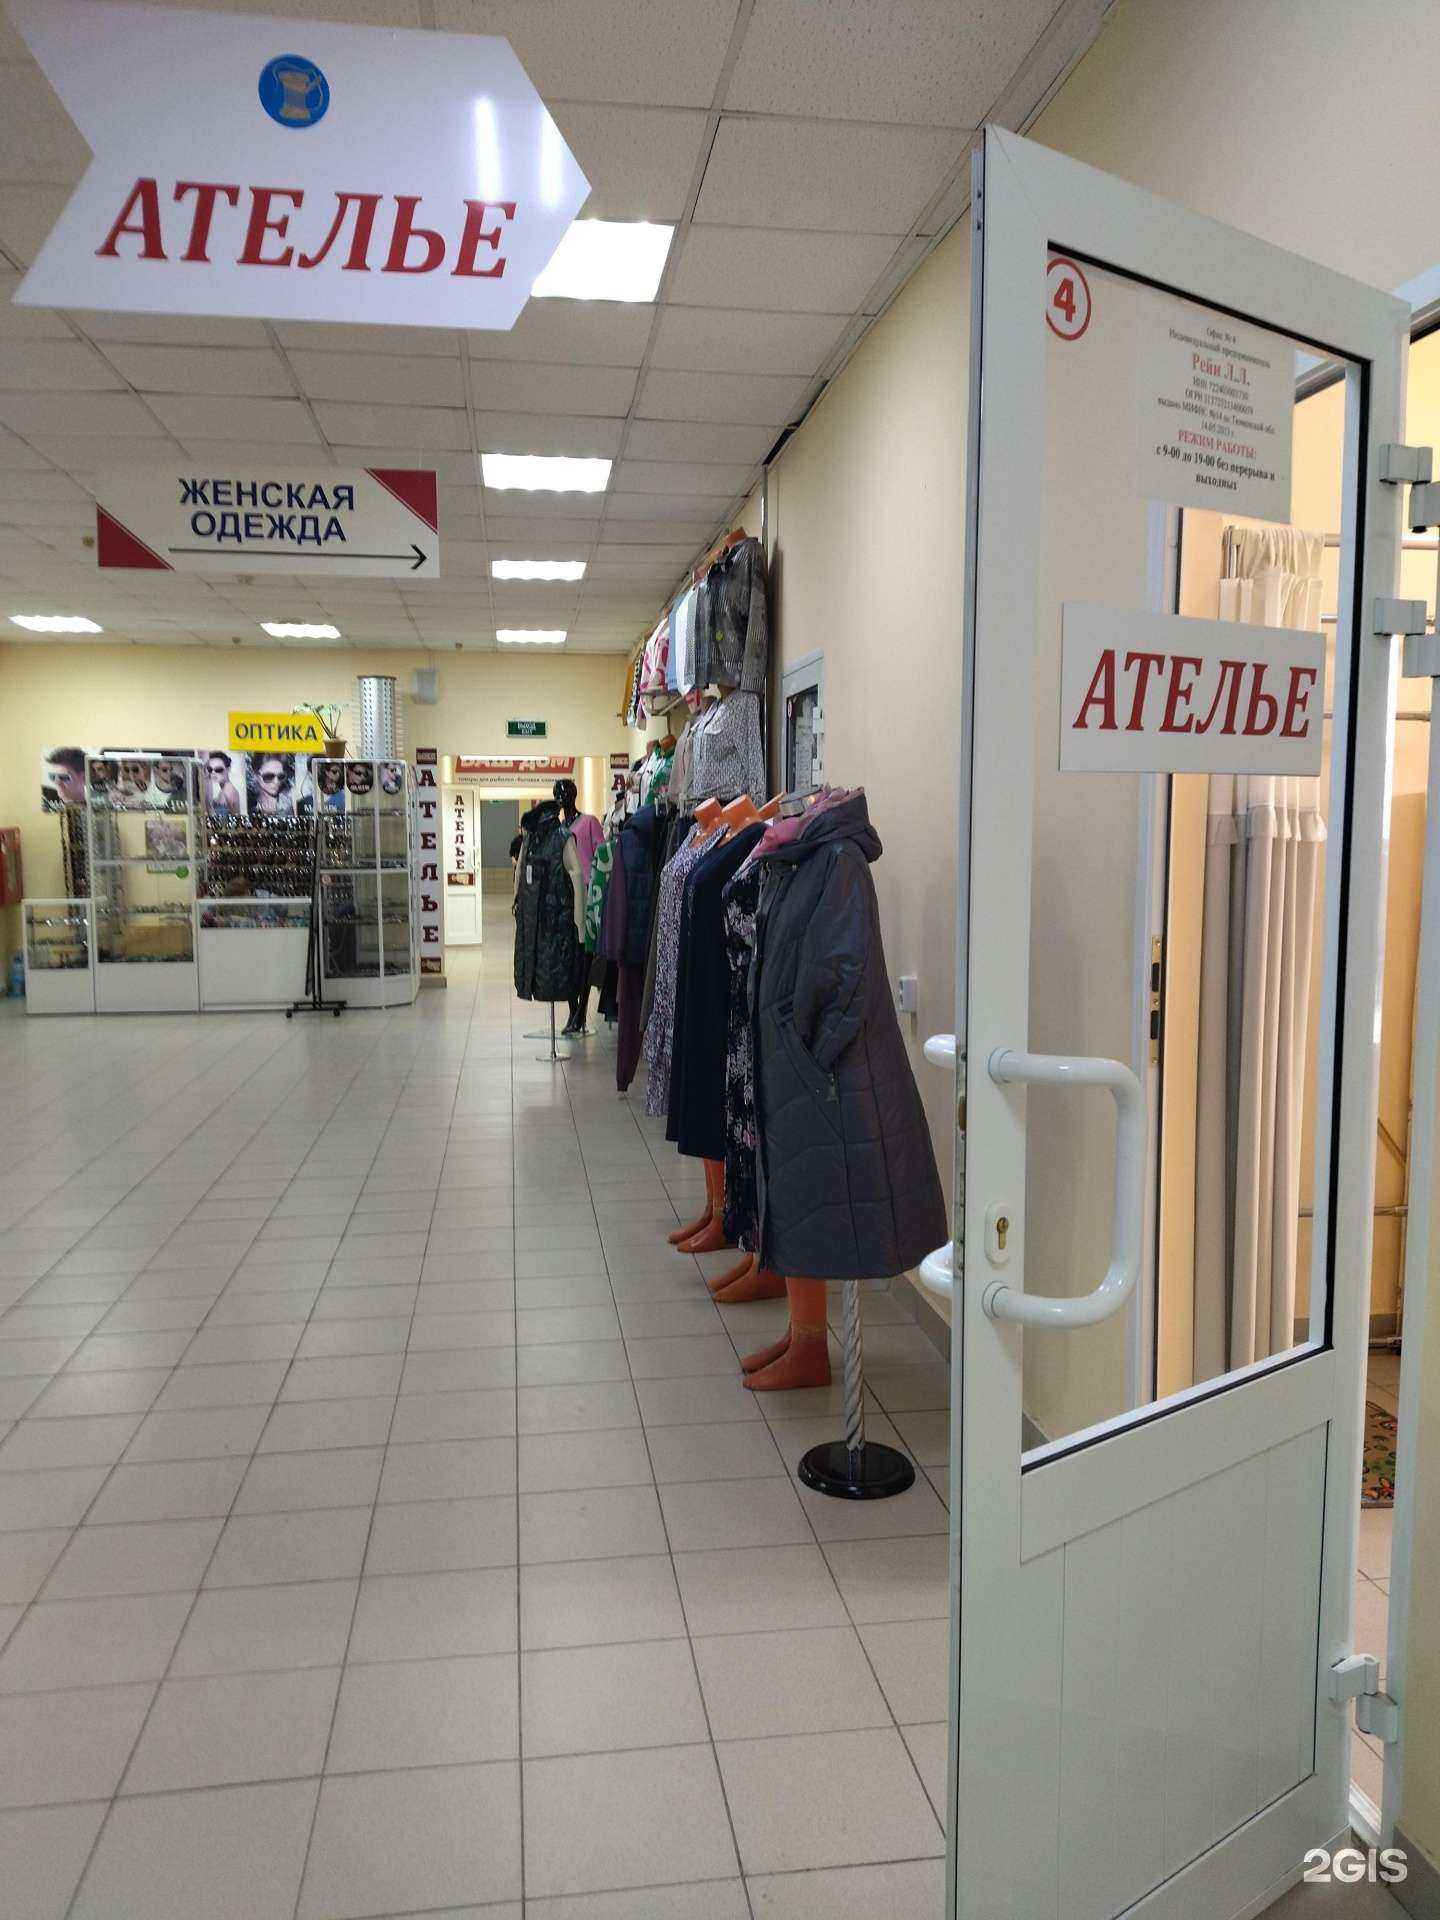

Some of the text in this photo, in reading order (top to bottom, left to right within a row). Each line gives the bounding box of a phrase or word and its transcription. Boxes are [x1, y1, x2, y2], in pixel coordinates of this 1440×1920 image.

[94, 177, 517, 278] АТЕЛЬЕ
[1053, 277, 1076, 323] 4
[1162, 444, 1181, 459] 9-00
[1182, 452, 1192, 463] до
[1194, 452, 1215, 468] 19-00
[1216, 457, 1229, 472] без
[1230, 463, 1269, 481] перерыва
[1178, 429, 1257, 460] РЕЖИМ РАБОТЫ:
[178, 478, 355, 512] ЖЕНСКАЯ
[1195, 474, 1238, 491] выходных
[191, 510, 347, 546] ОДЕЖДА
[1071, 648, 1318, 738] АТЕЛЬЕ
[235, 722, 318, 741] ОПТИКА
[455, 794, 465, 871] АТЕЛЬЕ
[419, 768, 439, 943] АТЕЛЬЕ
